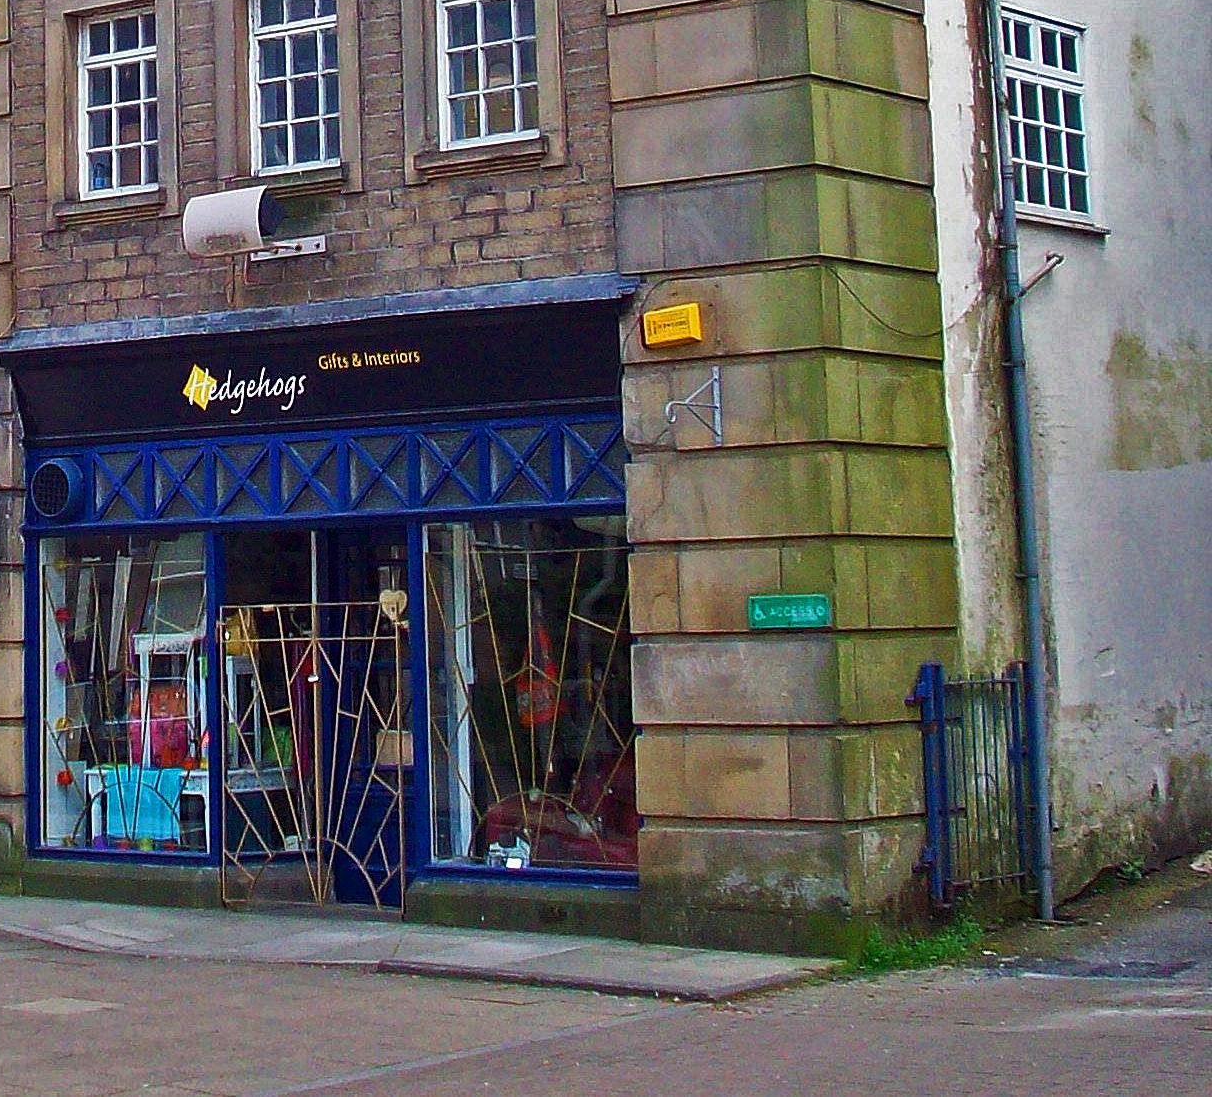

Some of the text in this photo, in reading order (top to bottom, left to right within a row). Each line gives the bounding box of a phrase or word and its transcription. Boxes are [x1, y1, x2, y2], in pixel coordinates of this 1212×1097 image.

[318, 349, 421, 370] Gifts & Interiors
[189, 367, 307, 414] Hedgehogs
